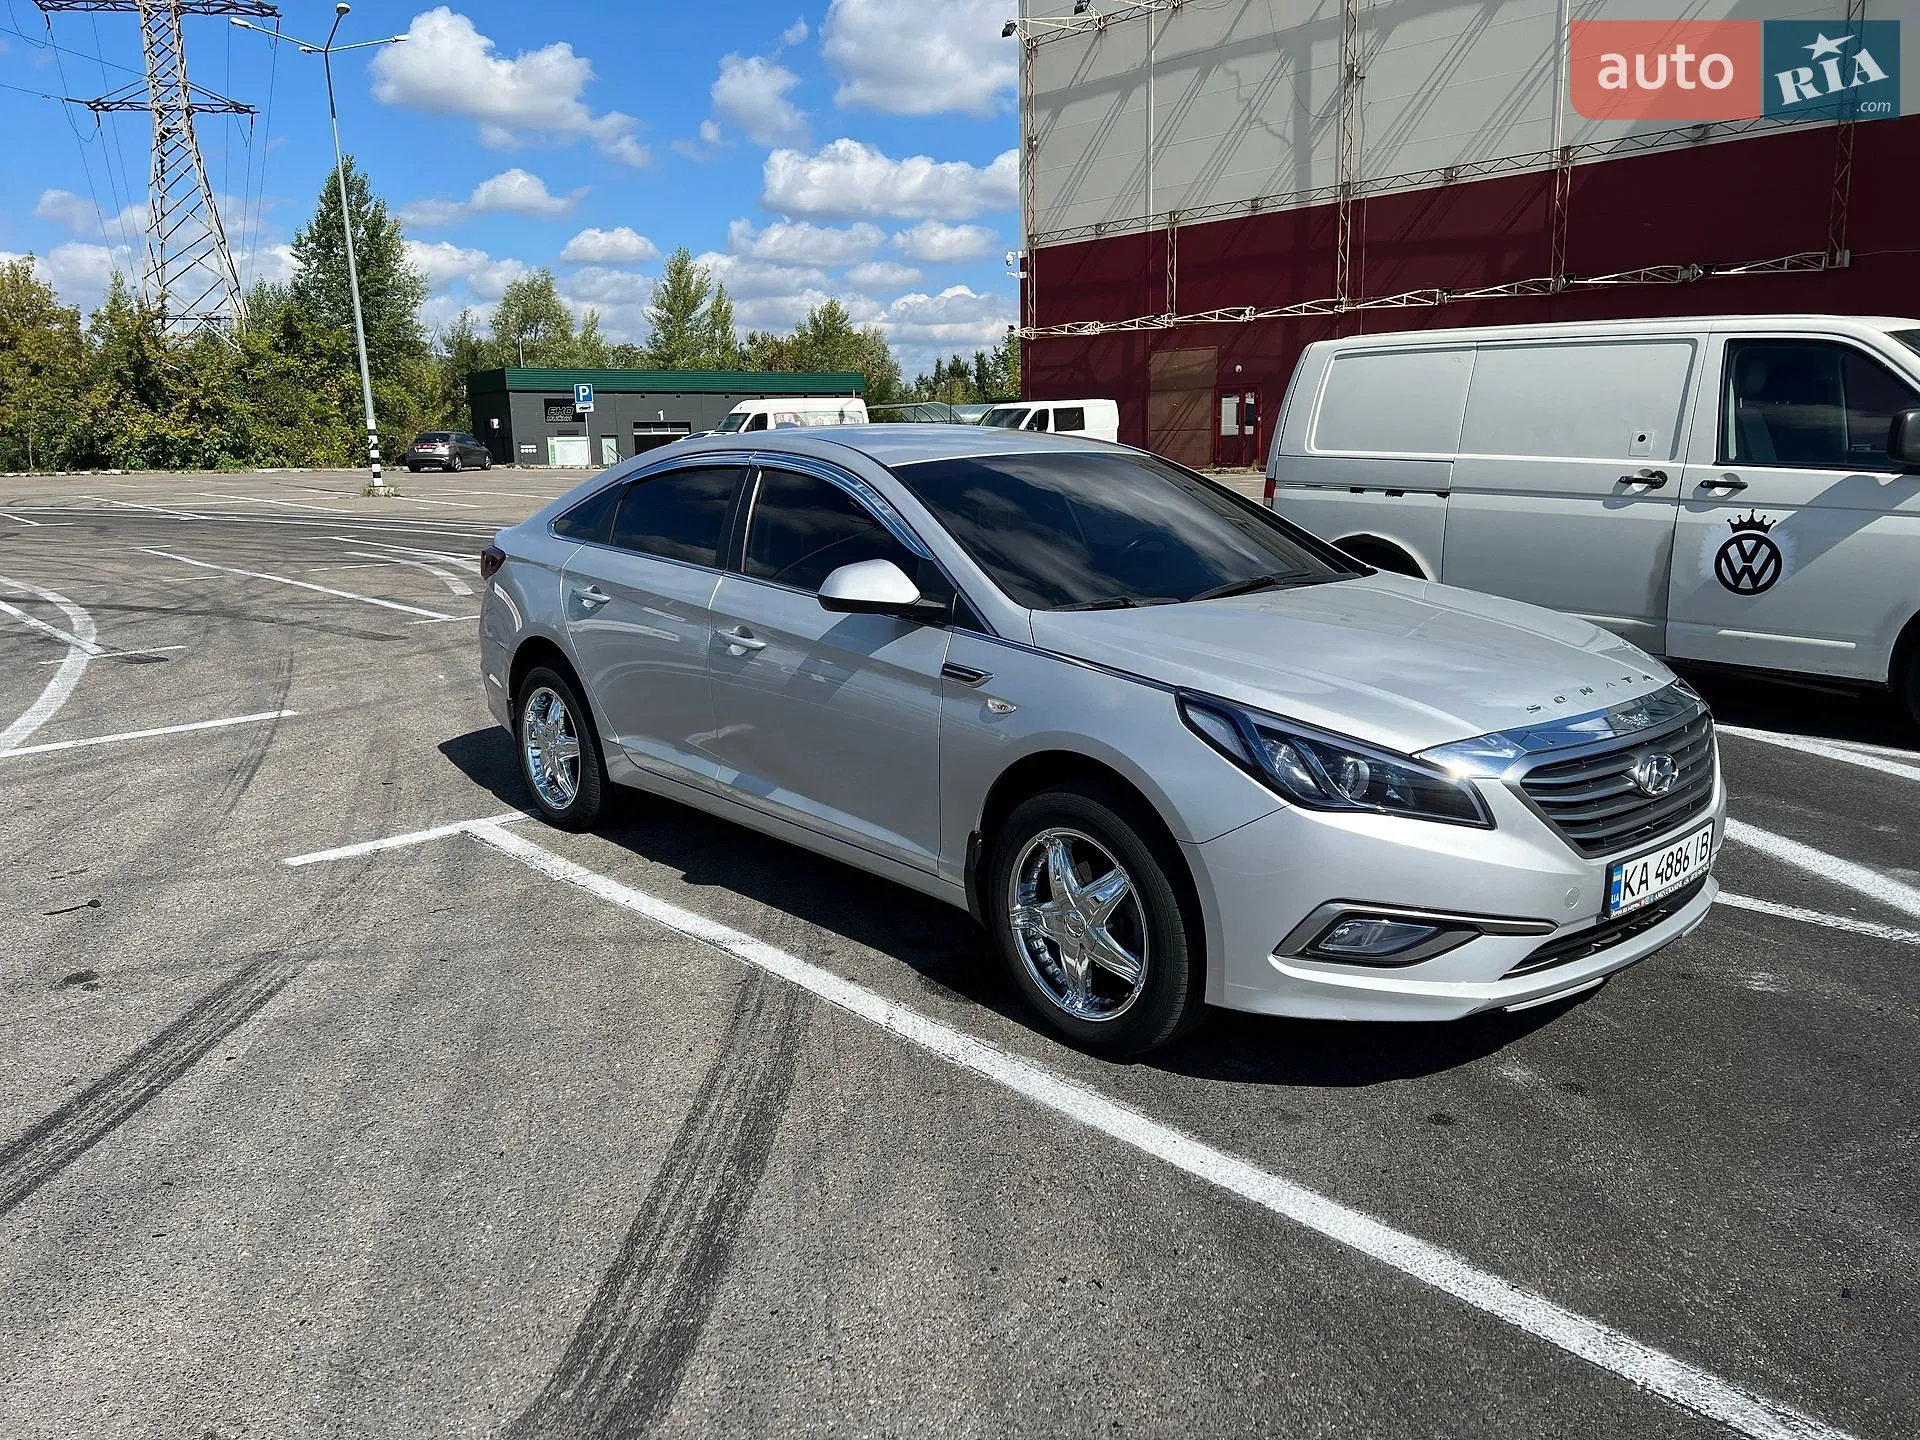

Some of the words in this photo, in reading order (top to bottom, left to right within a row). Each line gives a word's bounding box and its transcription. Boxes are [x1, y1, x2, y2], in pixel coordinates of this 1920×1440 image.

[579, 386, 590, 401] P
[657, 409, 665, 421] 1
[1526, 674, 1654, 714] SONATA
[1622, 862, 1649, 901] KA
[1655, 841, 1691, 885] 4886
[1694, 831, 1709, 866] IB
[1611, 892, 1620, 904] UA
